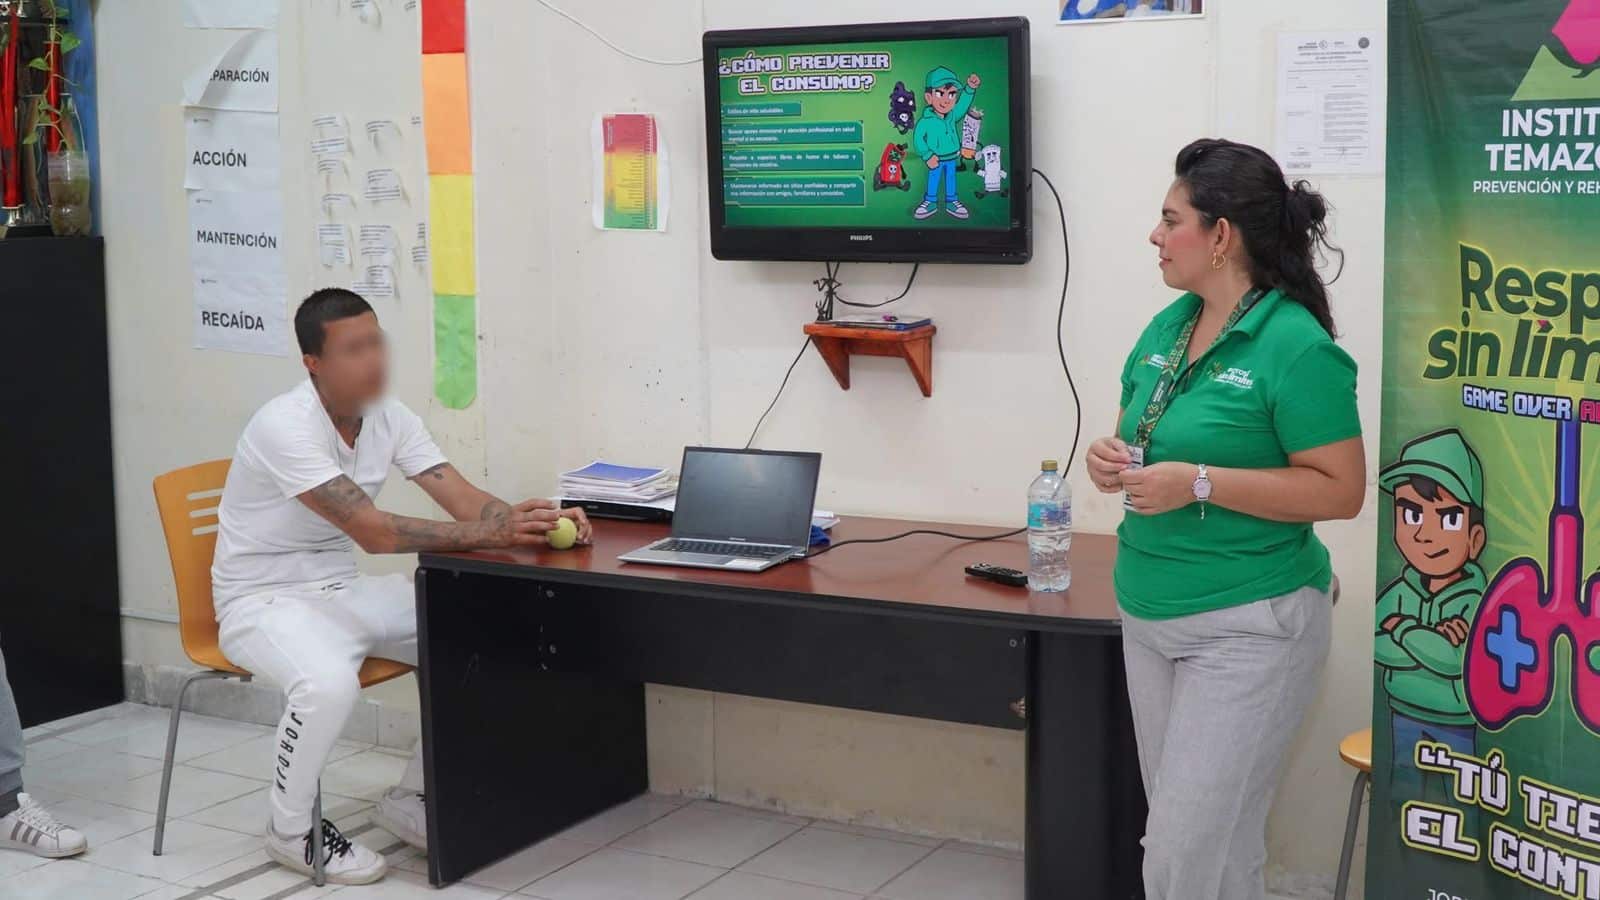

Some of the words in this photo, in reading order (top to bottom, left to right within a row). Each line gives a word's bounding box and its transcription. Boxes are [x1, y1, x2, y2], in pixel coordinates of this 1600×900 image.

[209, 67, 270, 83] PARACIÓN
[719, 53, 783, 75] ¿CÓMO
[789, 54, 889, 70] PREVENIR
[740, 78, 765, 93] EL
[771, 75, 874, 92] CONSUMO?
[1502, 107, 1600, 137] INSTIT
[193, 148, 247, 167] ACCIÓN
[1473, 177, 1561, 194] PREVENCIÓN
[1565, 180, 1575, 194] Y
[197, 230, 277, 249] MANTENCIÓN
[1459, 243, 1600, 335] Resp
[202, 310, 265, 331] RECAÍDA
[1423, 311, 1502, 379] sin
[1462, 385, 1507, 412] GAME
[1514, 391, 1572, 420] OVER
[1521, 781, 1600, 843] TIE
[1406, 806, 1476, 856] EL
[1491, 827, 1600, 900] CONT
